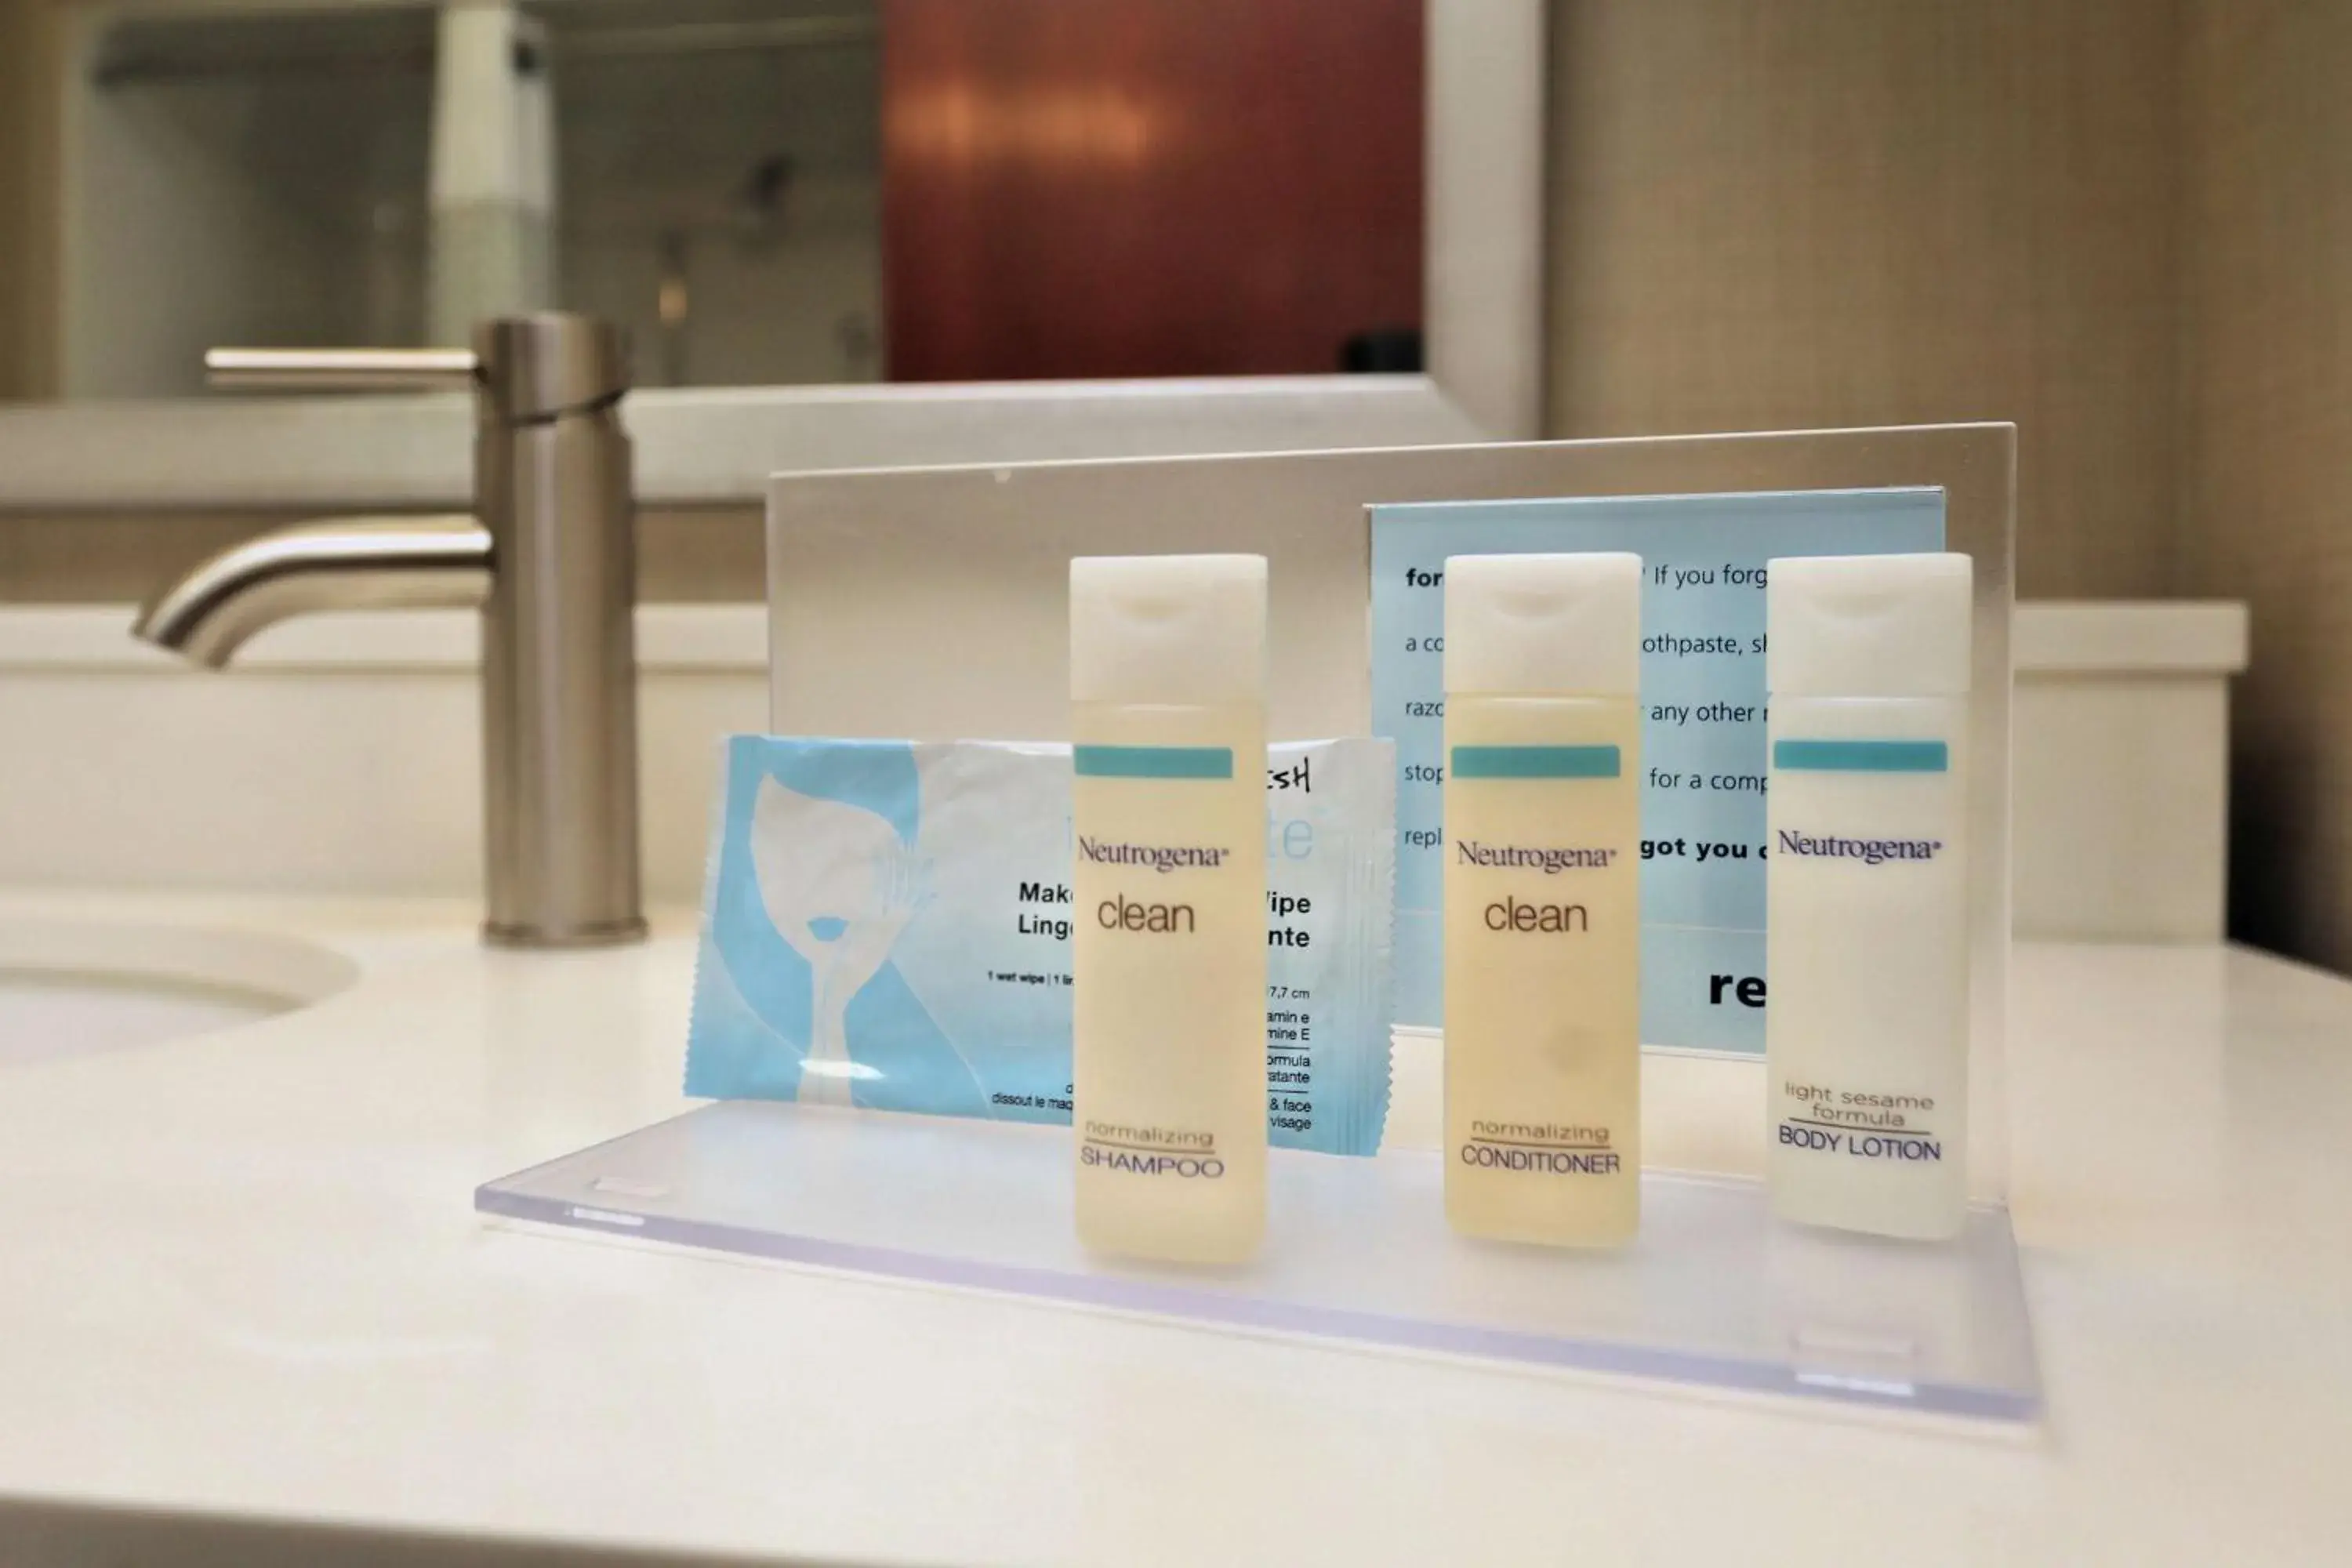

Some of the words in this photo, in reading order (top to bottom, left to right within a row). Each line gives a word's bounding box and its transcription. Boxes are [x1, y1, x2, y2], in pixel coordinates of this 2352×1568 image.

[1655, 564, 1668, 585] If
[1675, 570, 1715, 590] you
[1723, 564, 1768, 589] forg
[1406, 637, 1417, 652] a
[1642, 633, 1743, 657] othpaste,
[1651, 706, 1690, 726] any
[1696, 700, 1755, 722] other
[1650, 767, 1681, 788] for
[1690, 774, 1702, 789] a
[1405, 827, 1442, 848] repl
[1640, 837, 1686, 859] got
[1697, 842, 1748, 862] you
[1098, 891, 1195, 933] clean
[1266, 891, 1311, 916] ipe
[1484, 895, 1588, 932] clean
[1268, 927, 1311, 947] nte
[1291, 989, 1310, 1000] cm
[1710, 975, 1767, 1008] re
[1301, 1013, 1310, 1024] e
[1301, 1029, 1310, 1040] E
[1283, 1098, 1312, 1112] face
[1785, 1081, 1832, 1102] light
[1840, 1091, 1935, 1110] sesame
[1269, 1116, 1312, 1132] visage
[1812, 1102, 1905, 1127] formula
[1085, 1120, 1214, 1147] normalizing
[1471, 1120, 1610, 1143] normalizing
[1779, 1123, 1842, 1152] BODY
[1848, 1134, 1942, 1160] LOTION
[1080, 1145, 1225, 1178] SHAMPOO
[1461, 1144, 1621, 1174] CONDITIONER
